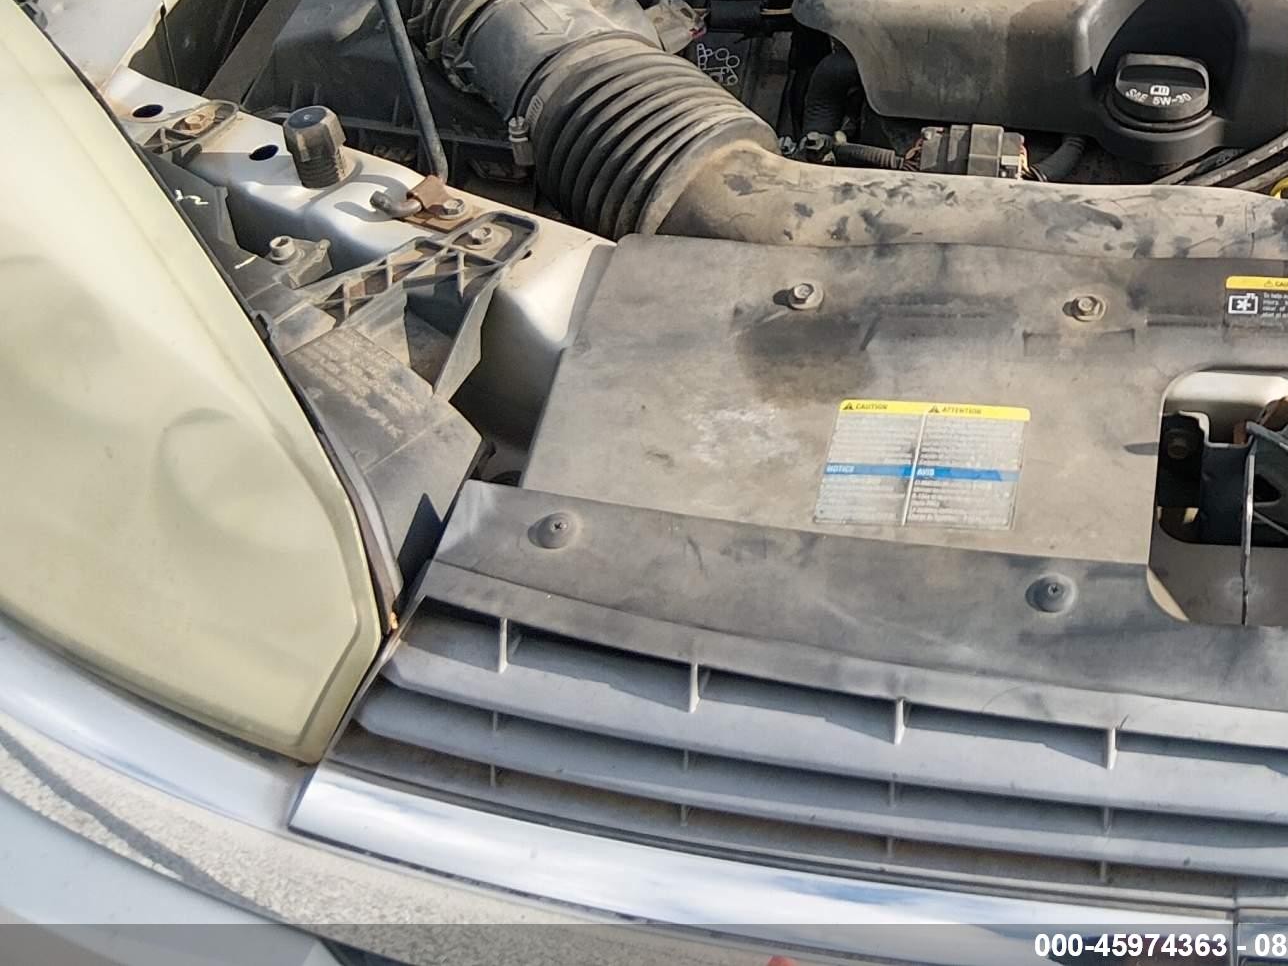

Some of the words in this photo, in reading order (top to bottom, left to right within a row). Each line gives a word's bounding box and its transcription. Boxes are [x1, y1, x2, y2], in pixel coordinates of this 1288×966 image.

[1126, 88, 1149, 103] SAE
[1152, 92, 1192, 106] 5W-30
[942, 406, 982, 415] ATTENTION
